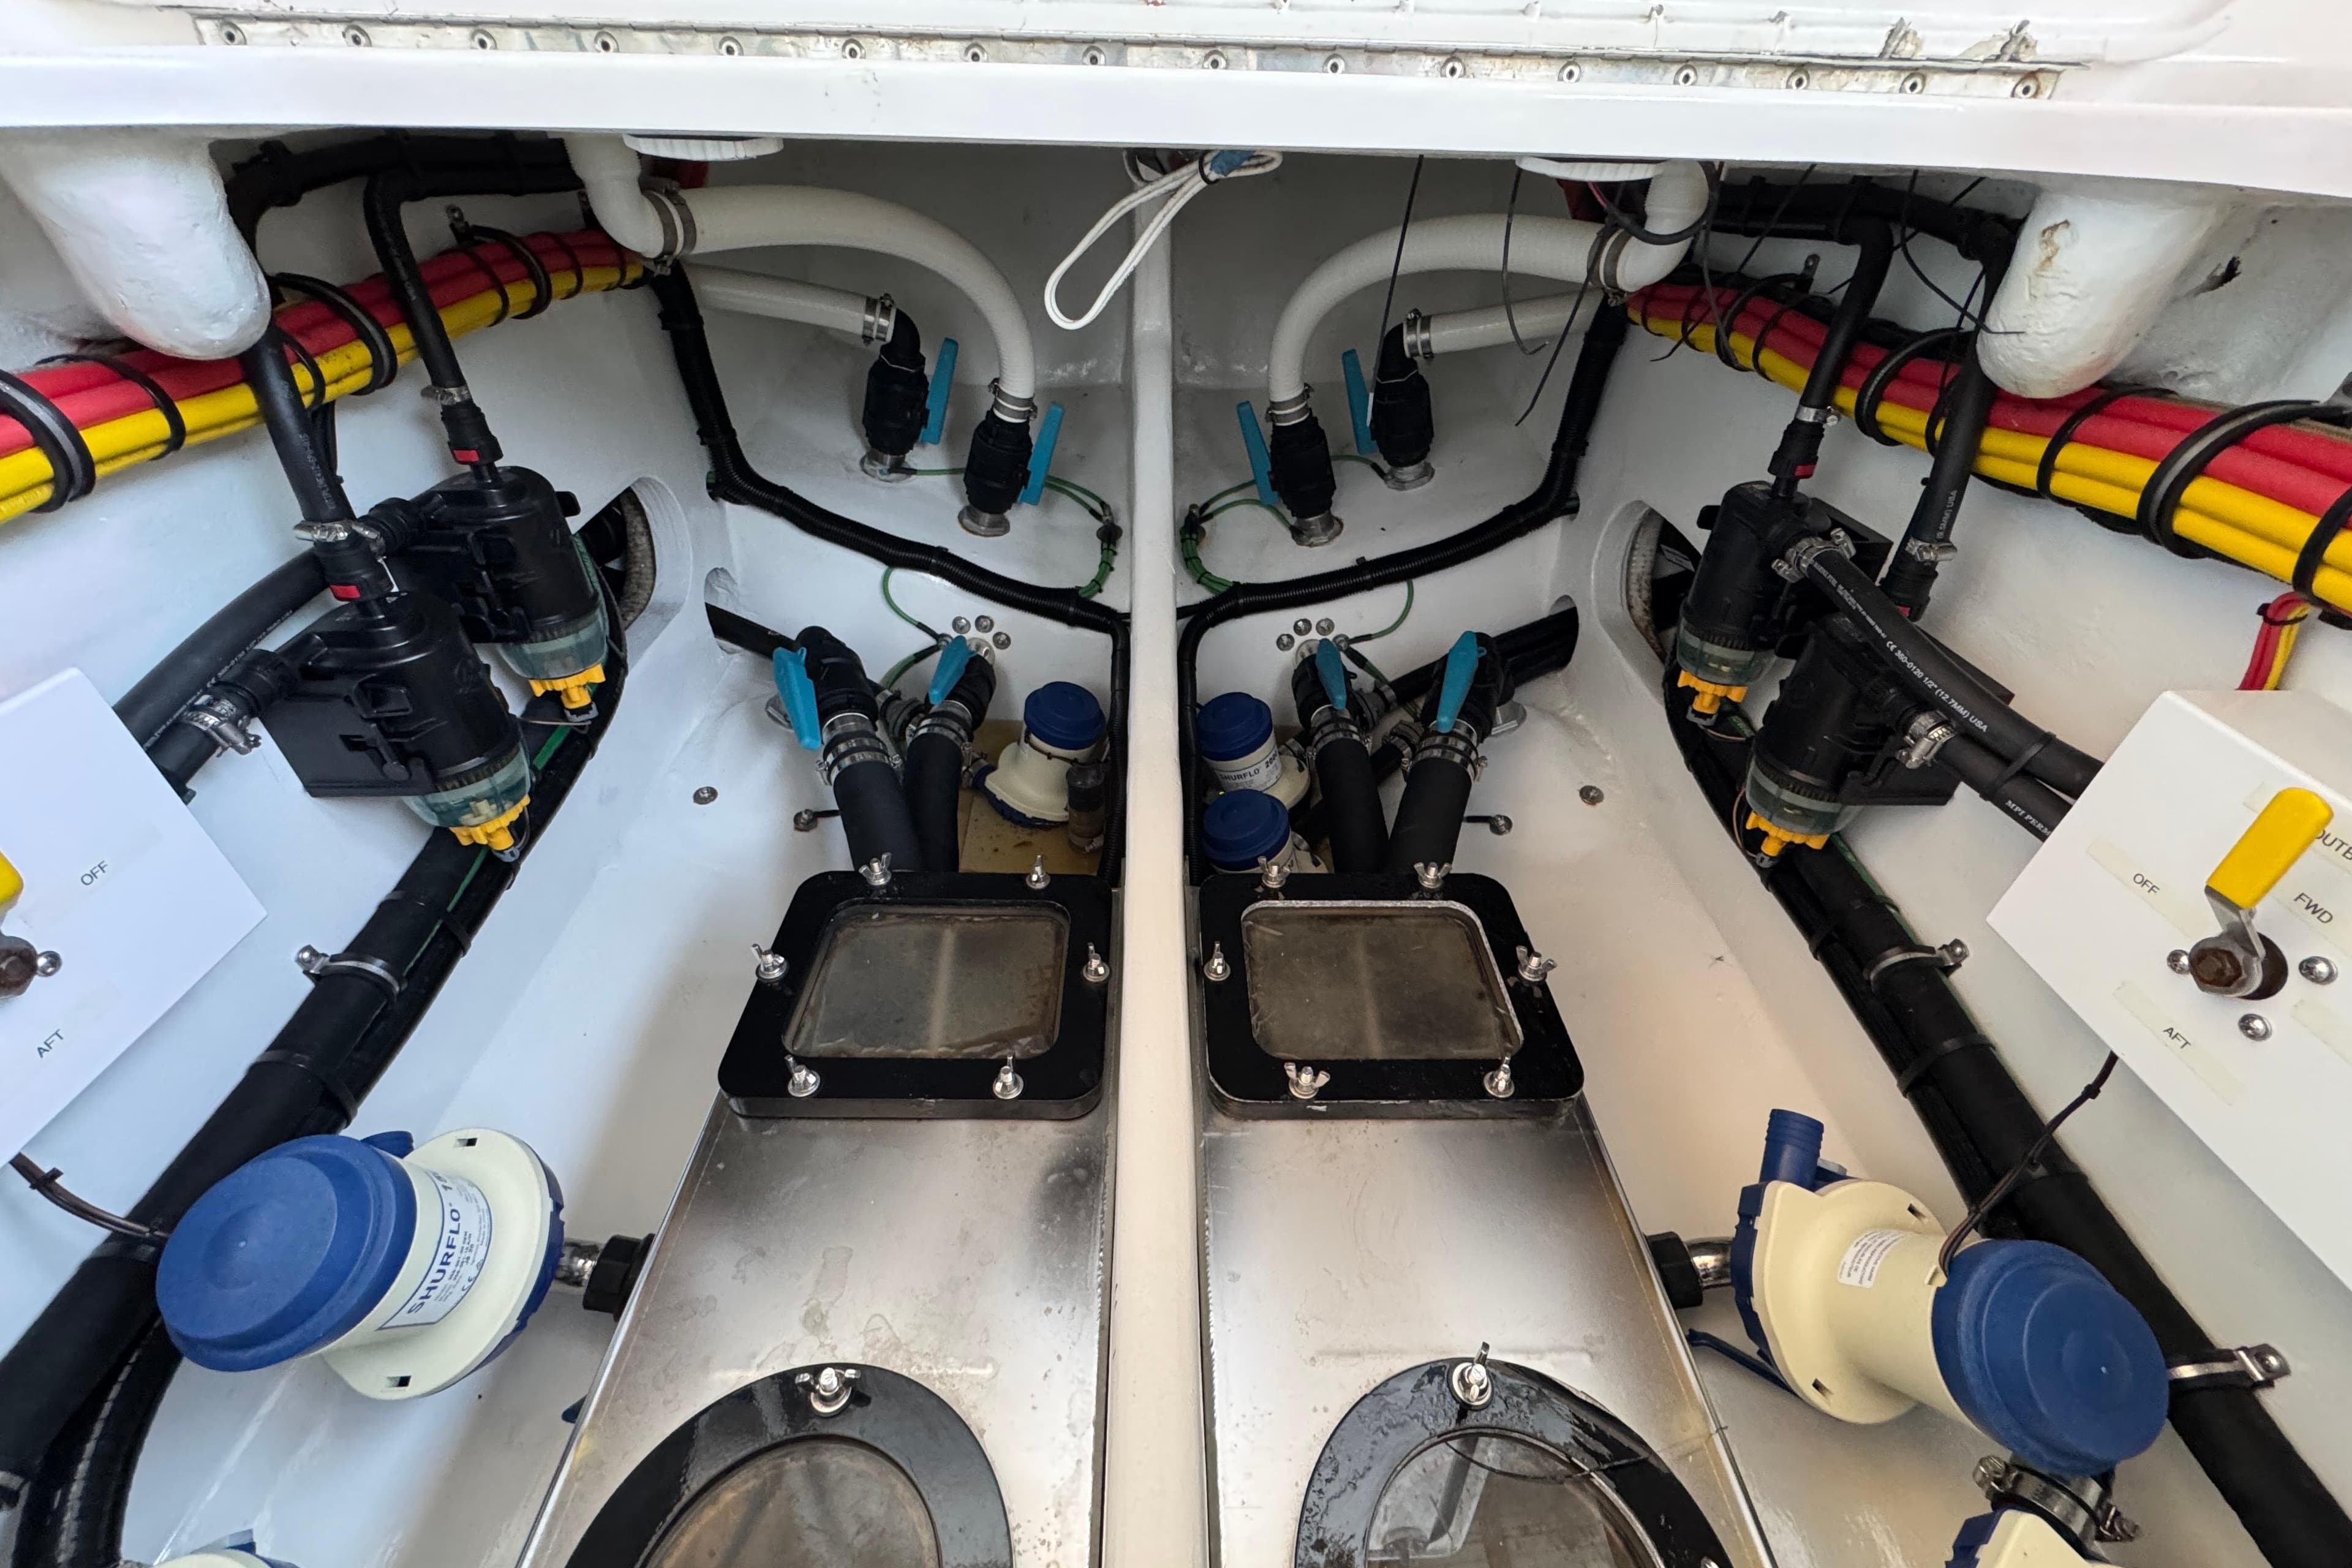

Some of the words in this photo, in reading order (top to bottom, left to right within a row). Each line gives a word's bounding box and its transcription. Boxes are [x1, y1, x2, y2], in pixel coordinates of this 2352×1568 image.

[1934, 689, 1970, 718] (12.7MM)
[1969, 715, 1988, 733] USA
[2005, 799, 2026, 816] MPI
[80, 860, 108, 886] OFF
[2133, 873, 2160, 894] OFF
[2293, 892, 2334, 924] FWD
[37, 1028, 64, 1058] AFT
[2163, 1027, 2192, 1049] AFT
[407, 1208, 461, 1314] SHURFLO
